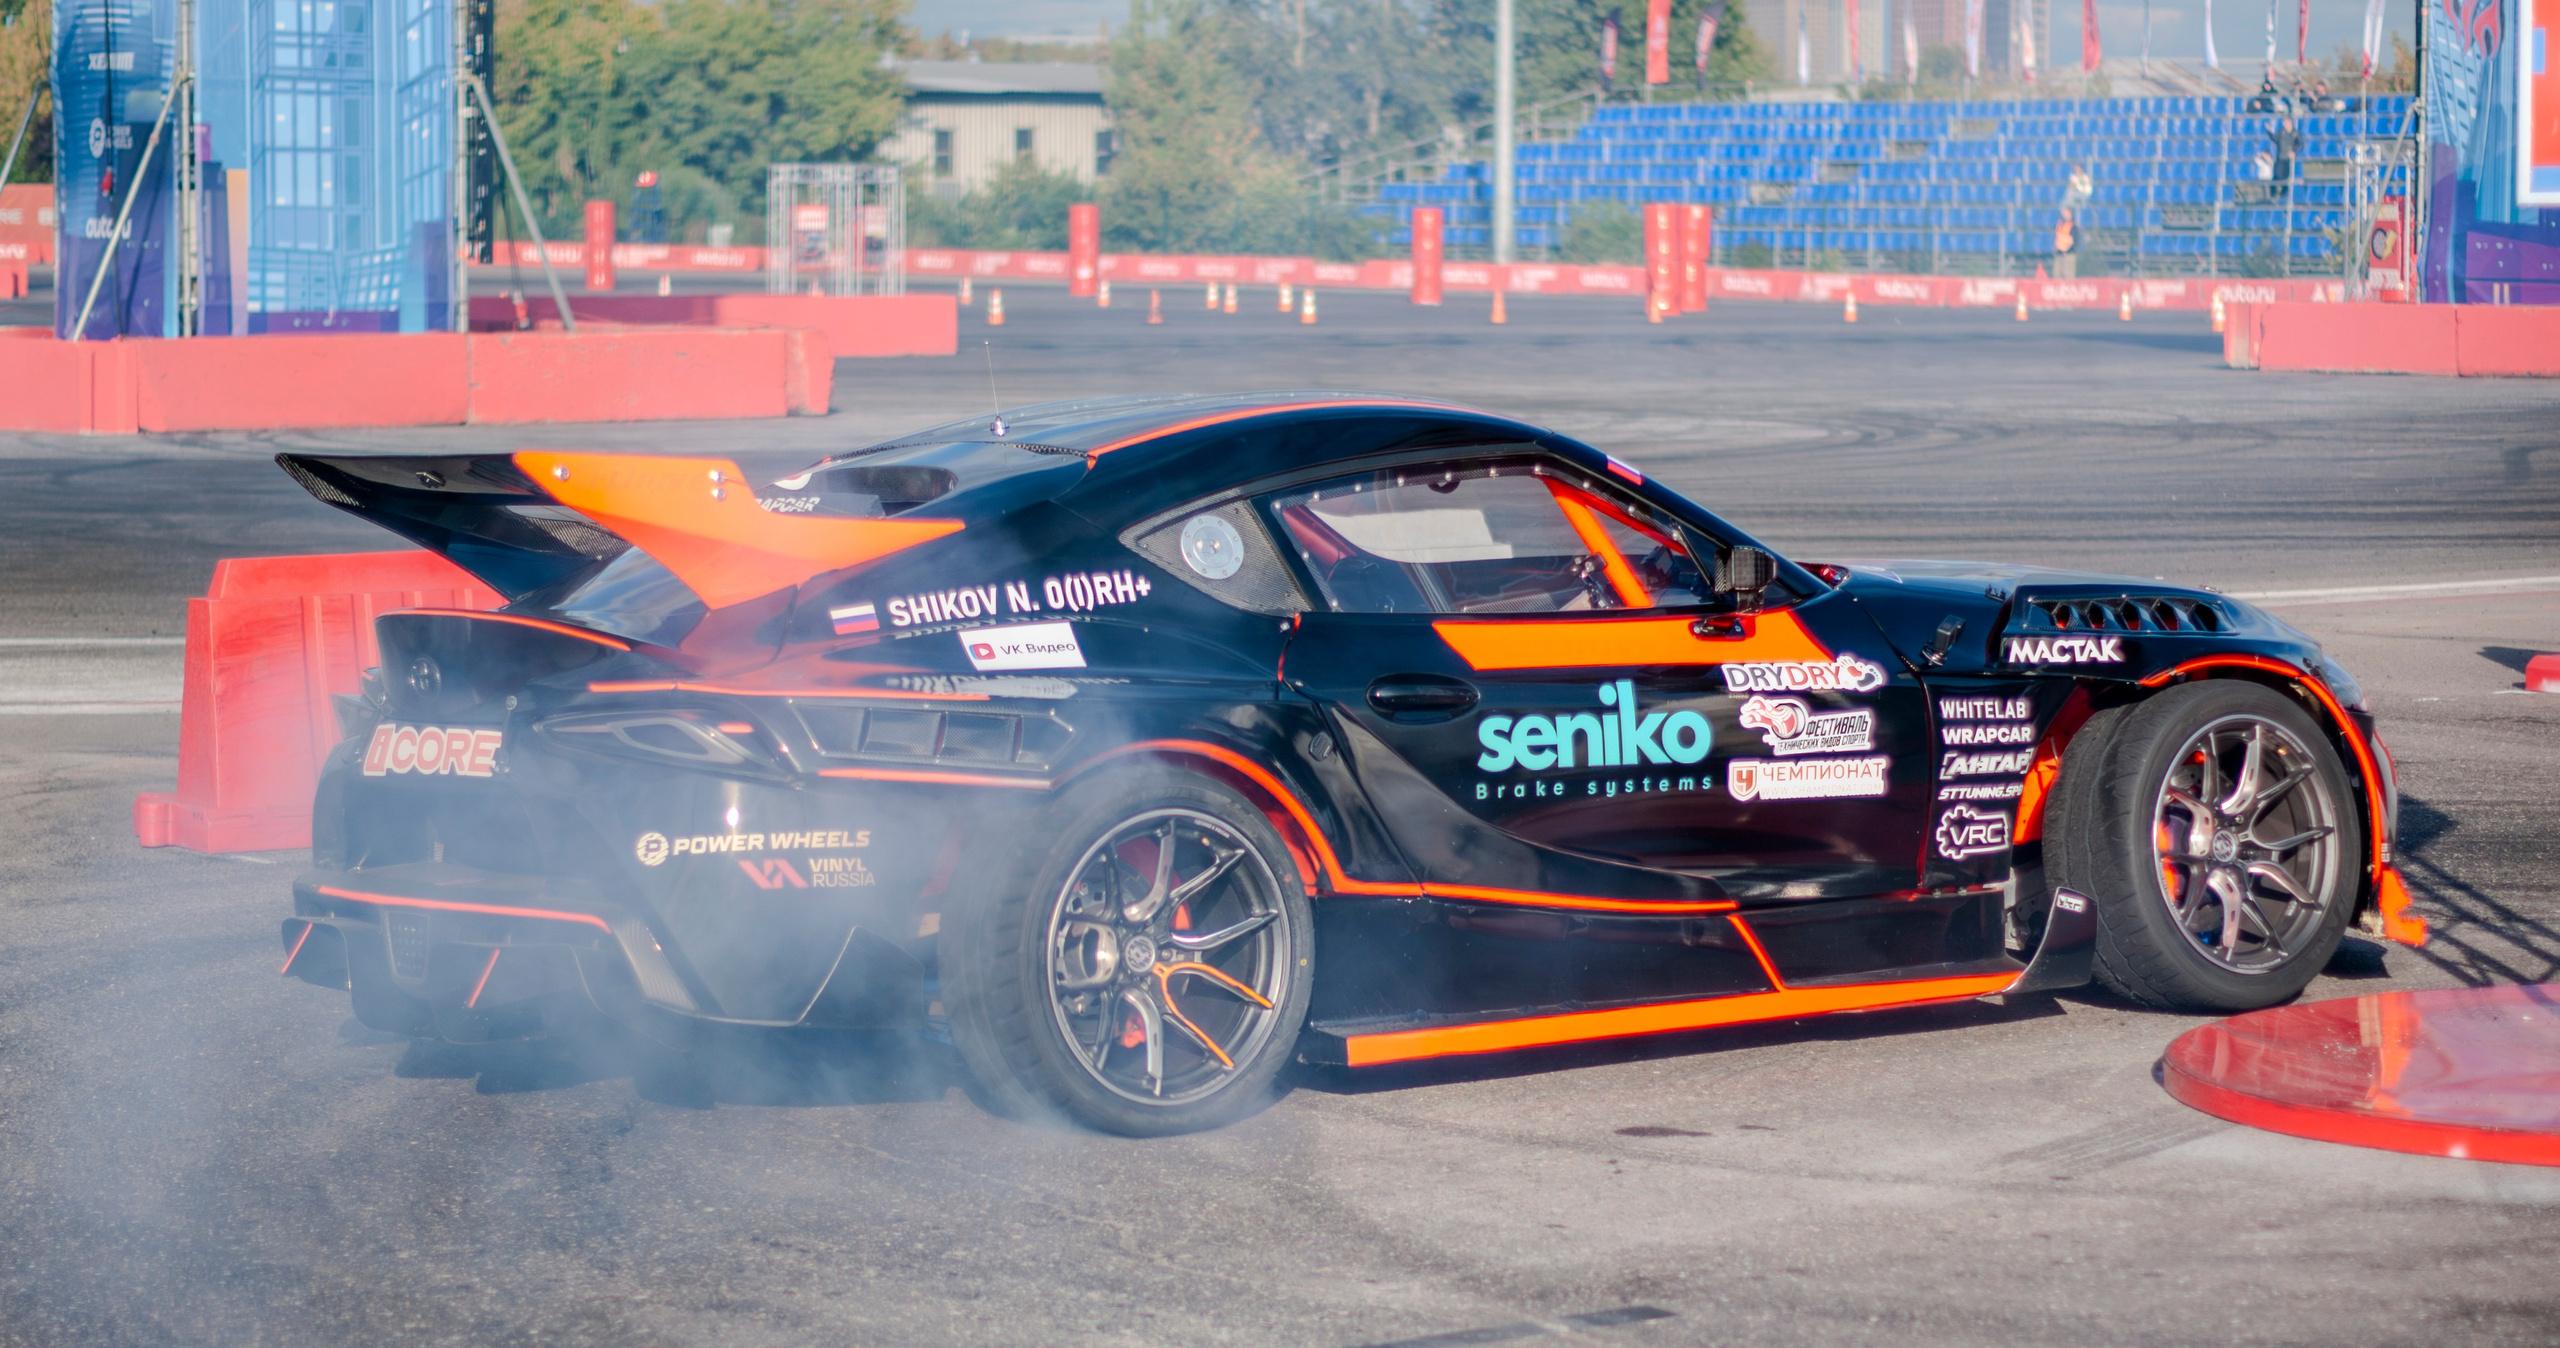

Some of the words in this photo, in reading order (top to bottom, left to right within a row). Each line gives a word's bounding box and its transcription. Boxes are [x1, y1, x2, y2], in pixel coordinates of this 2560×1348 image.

[889, 583, 997, 627] SHIKOV
[1006, 582, 1040, 613] N.
[1000, 645, 1023, 656] VK
[1027, 641, 1076, 654] Видео
[1940, 700, 2026, 719] WHITELAB
[1477, 680, 1711, 772] seniko
[1805, 714, 1869, 737] ФЕСТИВАЛЬ
[1942, 727, 2031, 744] WRAPCAR
[1777, 739, 1819, 752] ТЕХНИЧЕСКИХ
[1820, 735, 1841, 748] ВИДОВ
[1842, 733, 1866, 745] СПОРТА
[1763, 762, 1883, 782] ЧЕМПИОНАТ
[1476, 781, 1564, 800] Brake
[1588, 775, 1712, 797] systems
[674, 833, 765, 855] POWER
[771, 831, 871, 849] WHEELS
[1949, 823, 2003, 846] VRC
[809, 857, 868, 873] VINYL
[813, 873, 876, 888] RUSSIA
